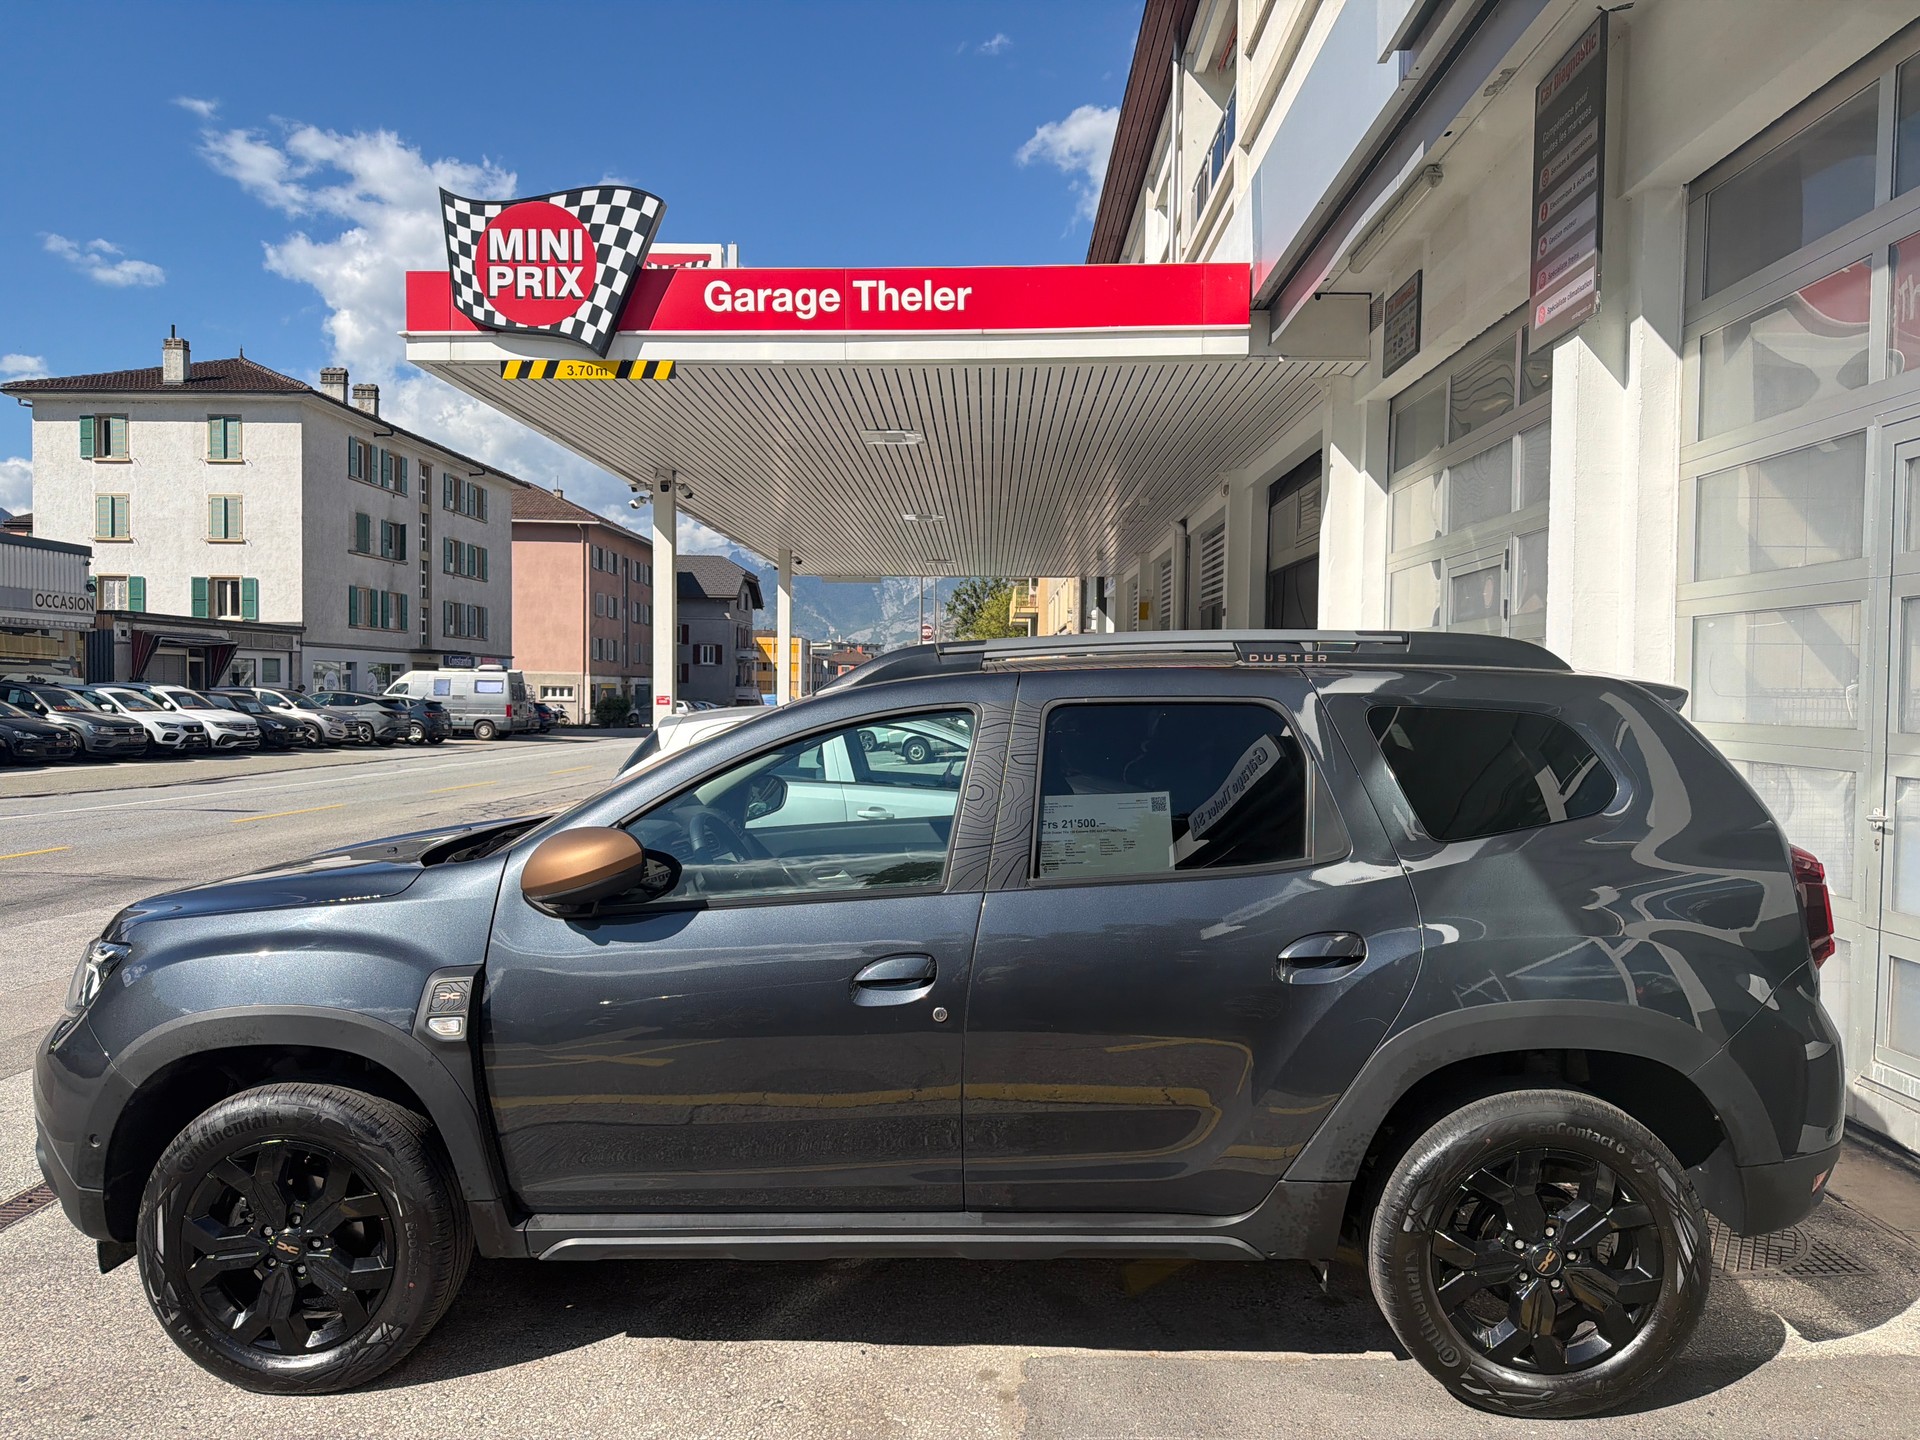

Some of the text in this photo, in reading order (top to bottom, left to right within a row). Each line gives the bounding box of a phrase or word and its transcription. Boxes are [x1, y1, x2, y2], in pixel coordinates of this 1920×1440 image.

[1553, 32, 1597, 91] Diagnostic
[487, 228, 583, 263] MINI
[487, 266, 585, 299] PRIX
[703, 279, 972, 320] Garage Theler
[35, 593, 94, 612] OCCASION
[1249, 653, 1328, 662] DUSTER
[178, 1111, 268, 1172] Continental
